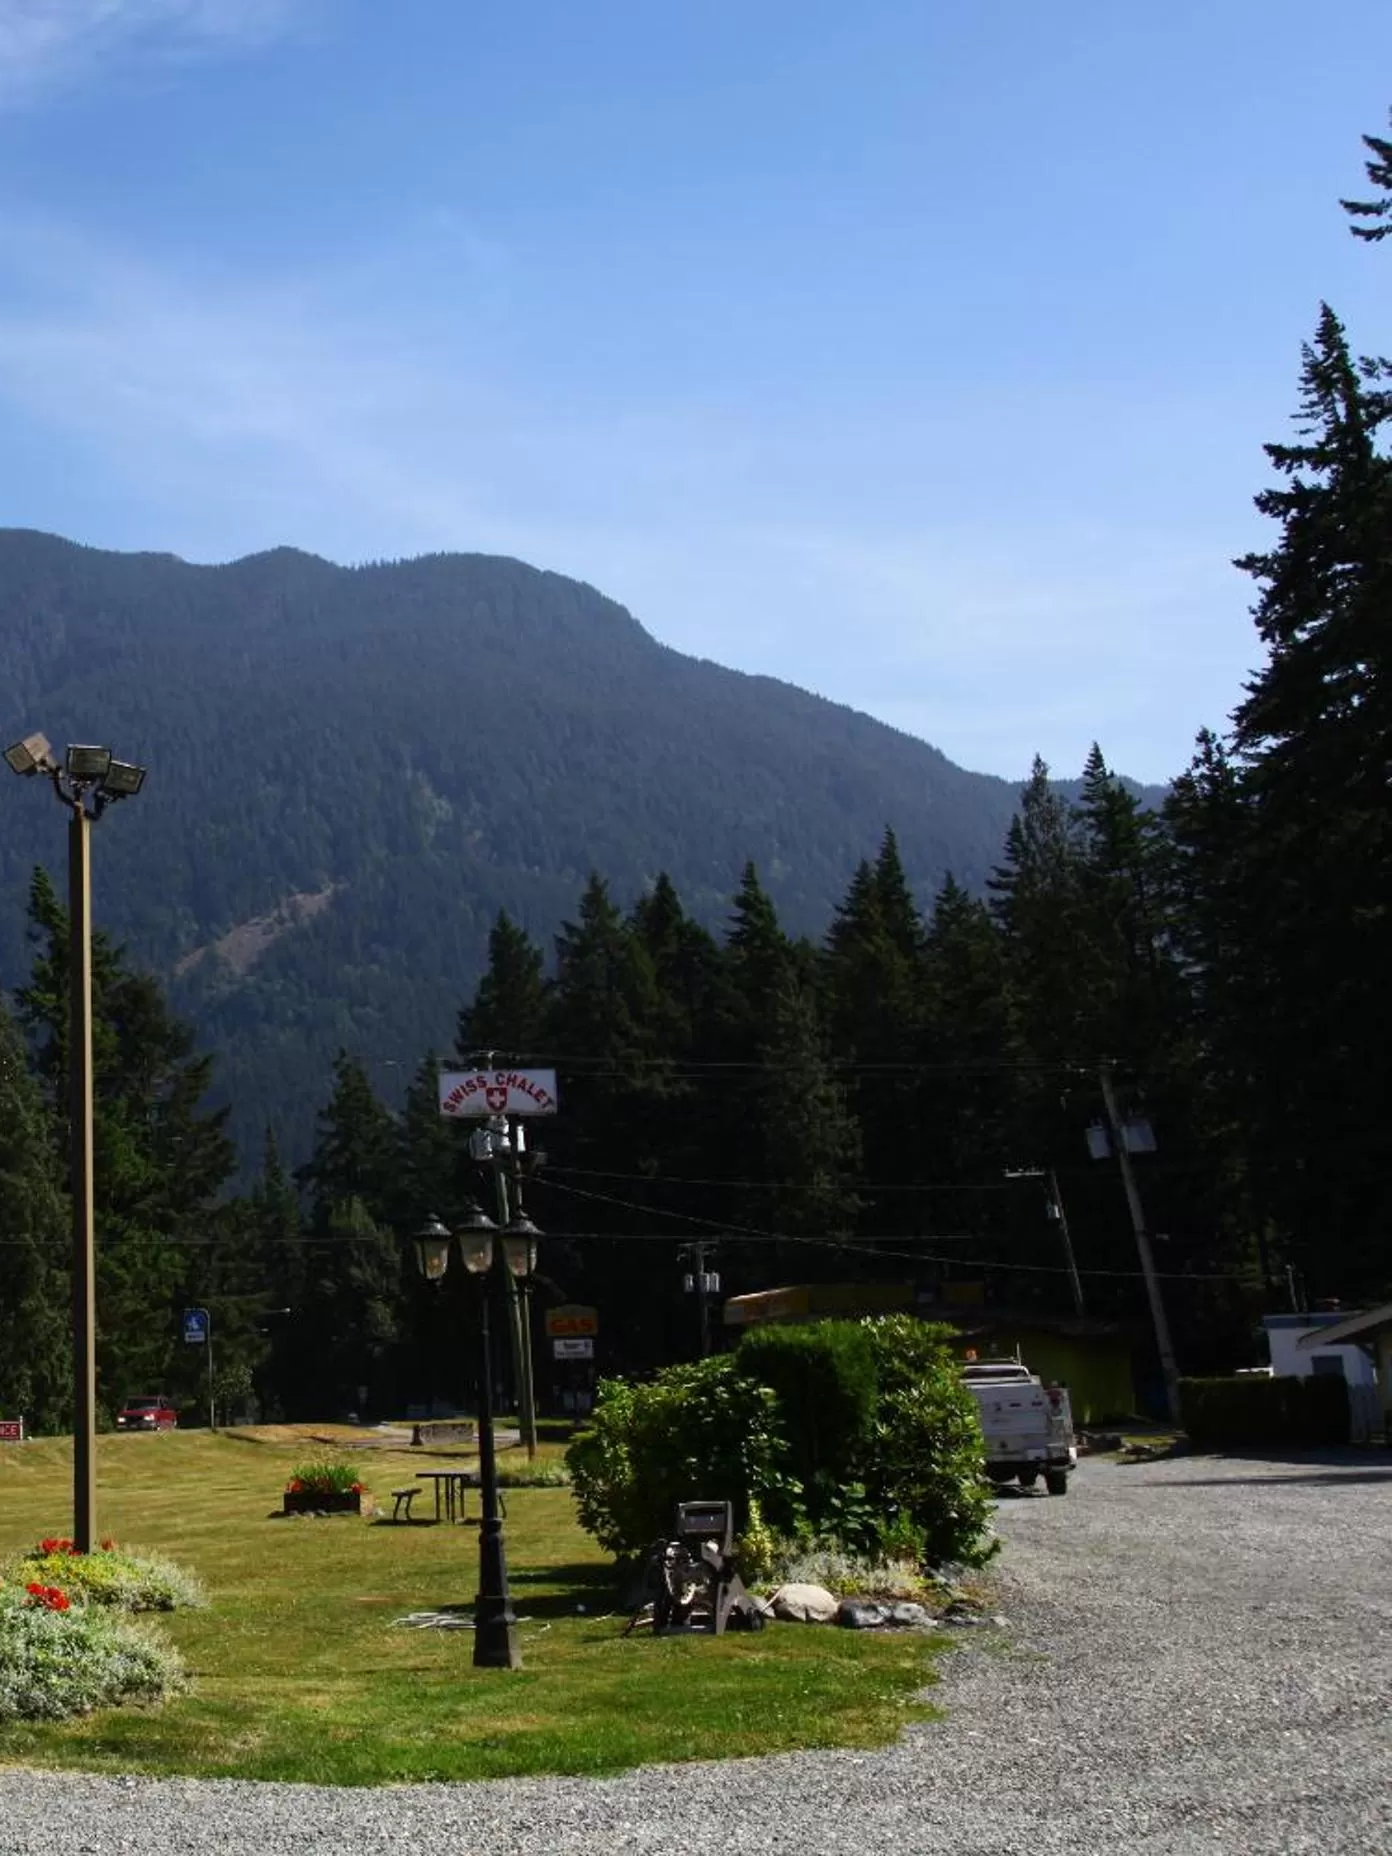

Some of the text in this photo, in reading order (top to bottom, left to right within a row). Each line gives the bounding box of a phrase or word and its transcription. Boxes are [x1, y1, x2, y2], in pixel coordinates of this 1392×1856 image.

[443, 1072, 554, 1112] SWISS CHALET
[551, 1318, 593, 1333] GAS
